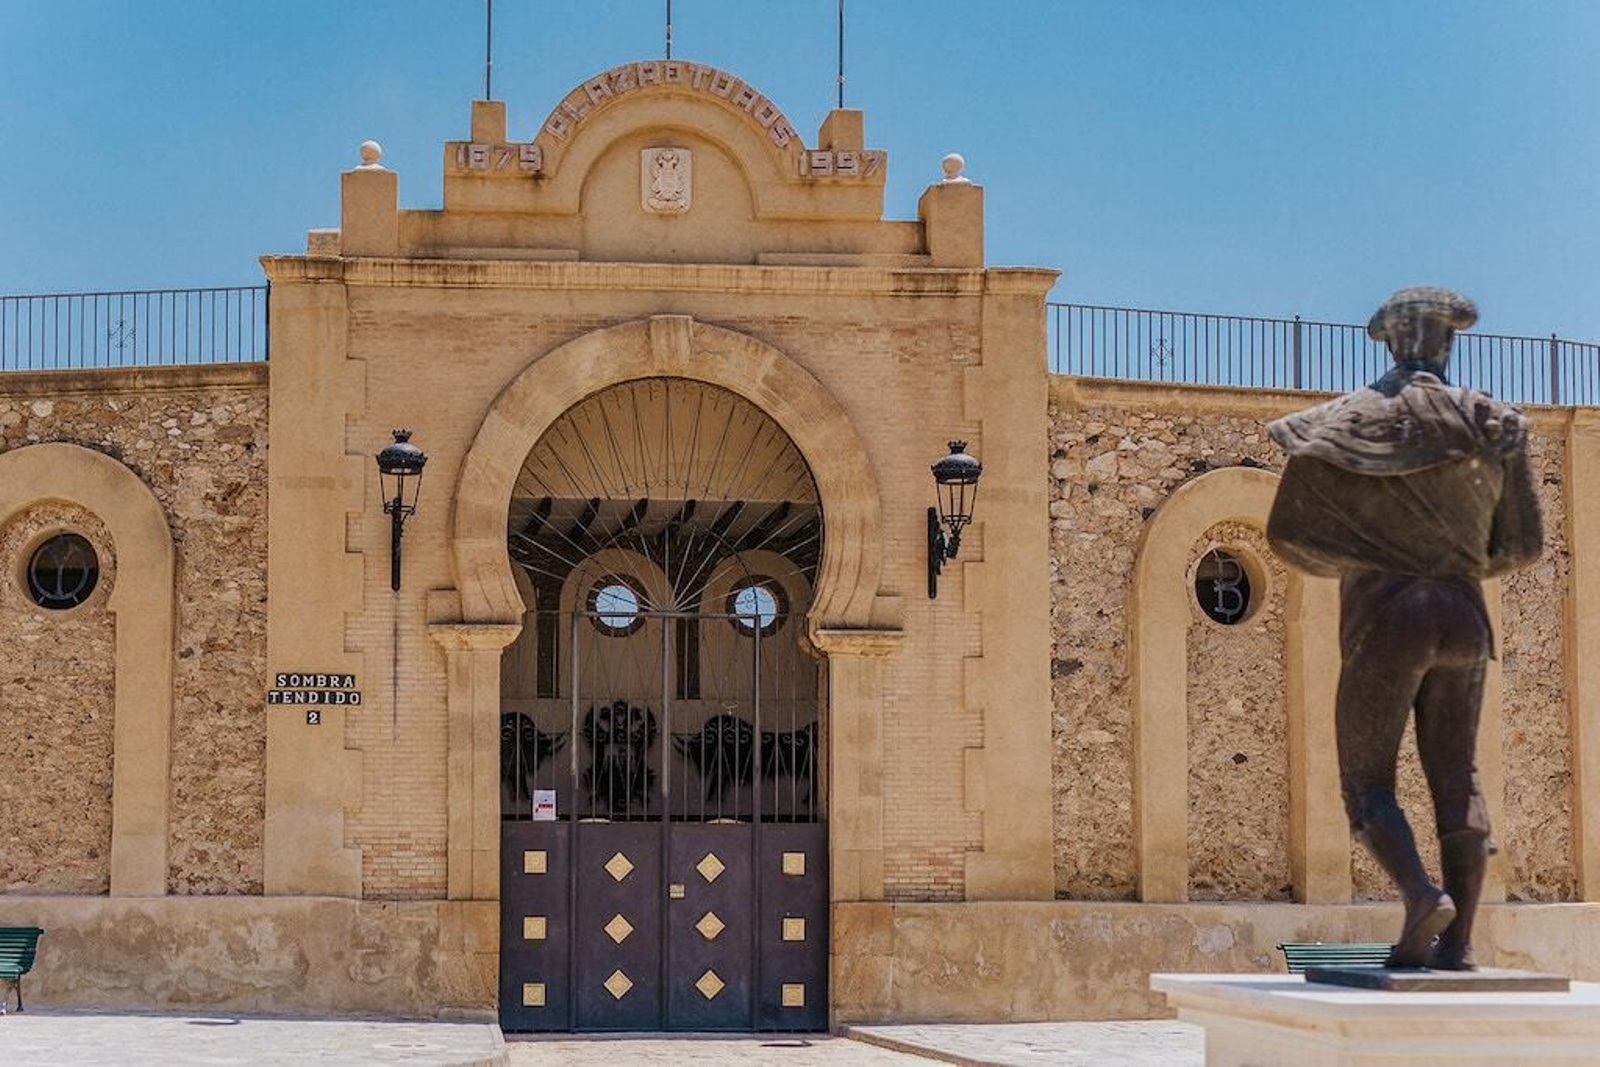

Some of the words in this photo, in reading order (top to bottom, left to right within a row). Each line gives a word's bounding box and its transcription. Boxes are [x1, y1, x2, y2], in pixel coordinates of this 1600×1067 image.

[546, 61, 661, 141] PLAZA
[688, 64, 795, 148] TOROS
[456, 143, 541, 171] 1879
[277, 674, 354, 688] SOMBRA
[269, 691, 360, 705] TENDIDO
[308, 711, 319, 724] 2
